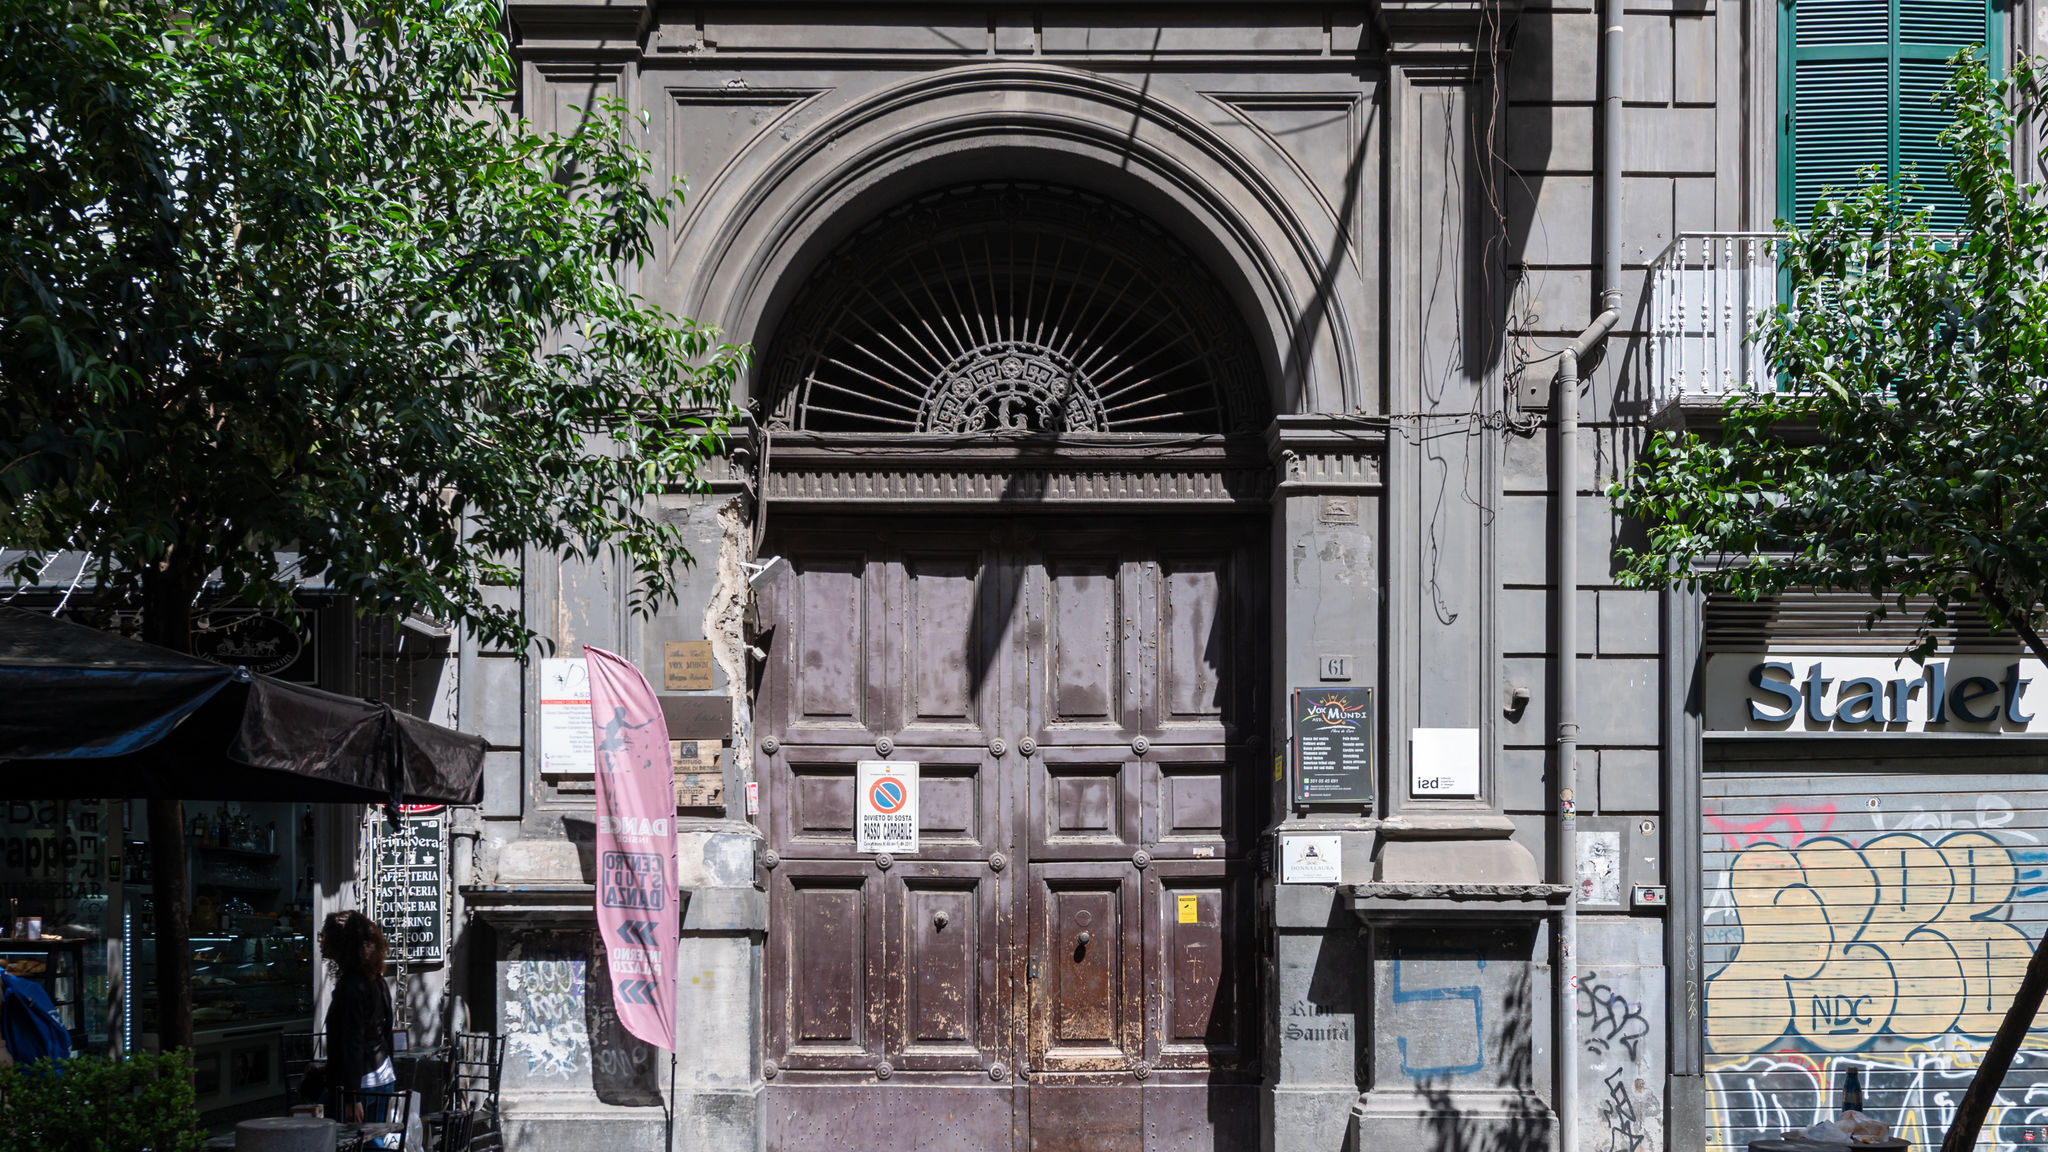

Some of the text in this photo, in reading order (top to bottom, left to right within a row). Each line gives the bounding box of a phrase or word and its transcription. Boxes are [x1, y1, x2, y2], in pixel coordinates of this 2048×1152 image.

[1328, 659, 1344, 676] 61
[1746, 661, 2036, 724] Starlet
[864, 822, 912, 840] PASSO CARRABILE
[418, 901, 438, 912] BAR
[406, 932, 434, 943] FOOD
[1812, 994, 1873, 1031] NDC
[1285, 1022, 1350, 1041] Sanità
